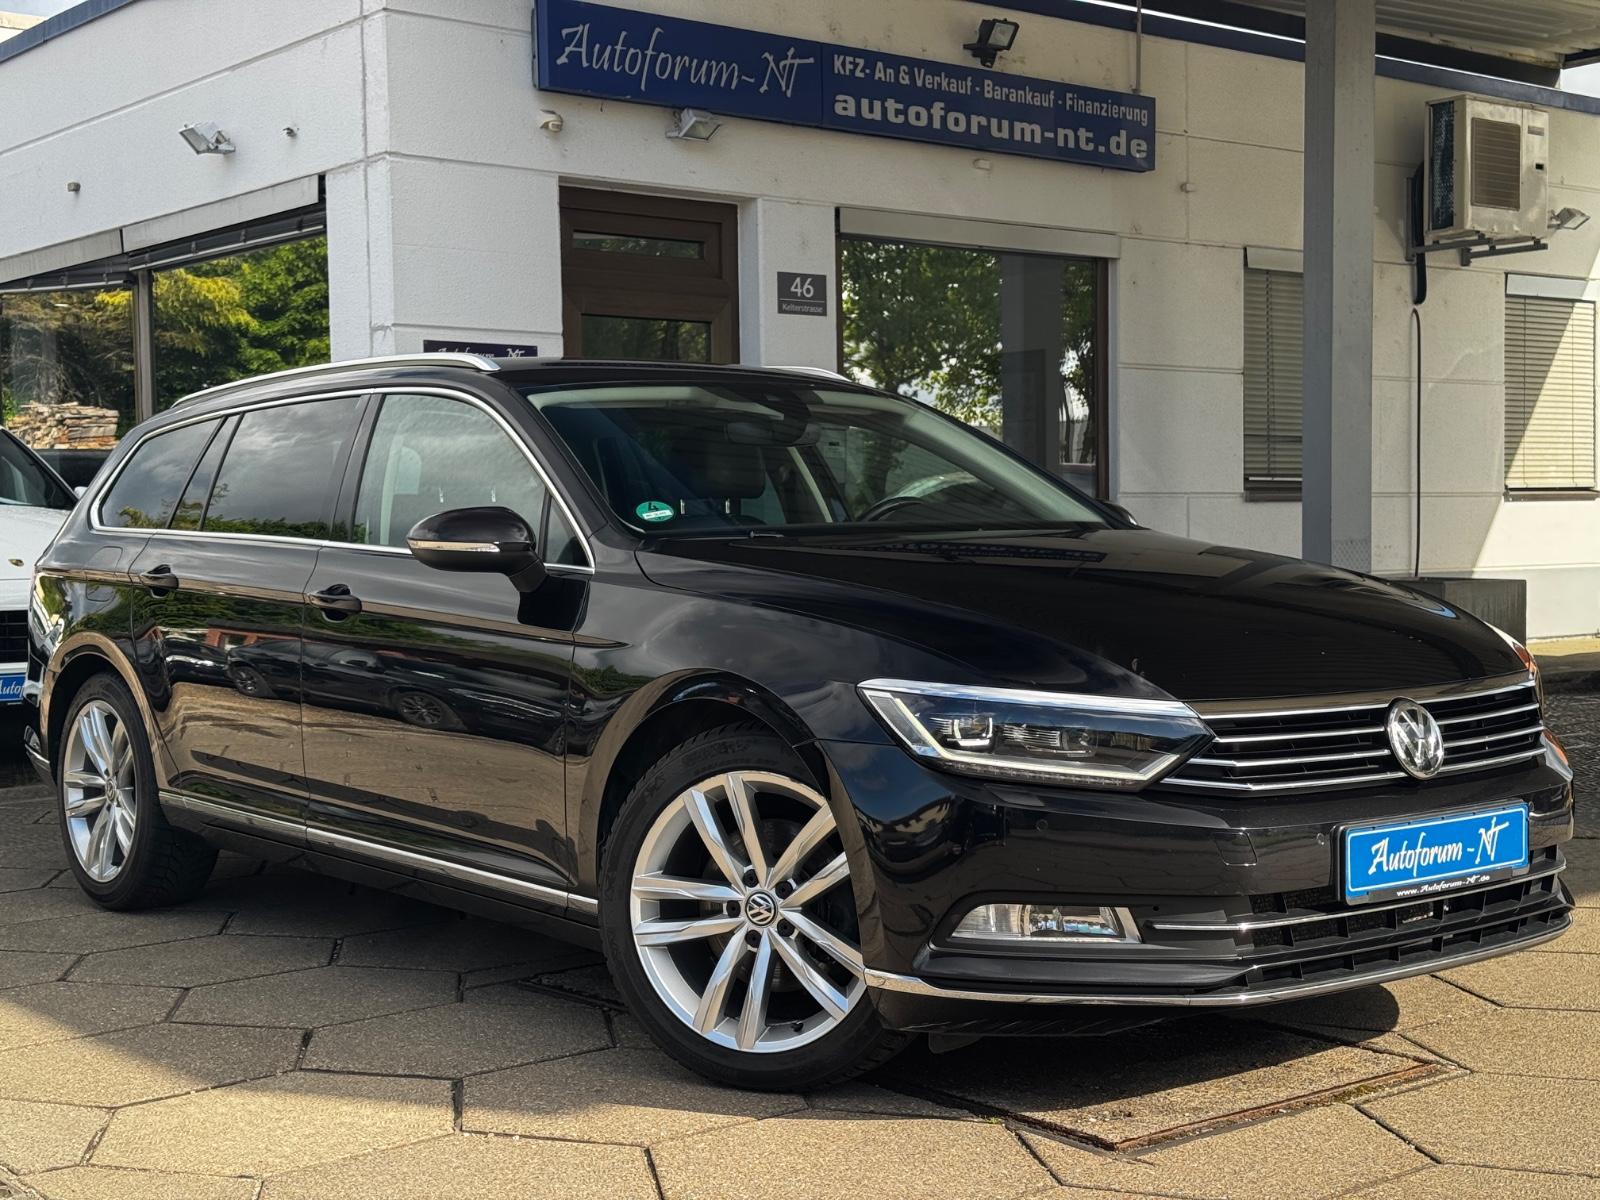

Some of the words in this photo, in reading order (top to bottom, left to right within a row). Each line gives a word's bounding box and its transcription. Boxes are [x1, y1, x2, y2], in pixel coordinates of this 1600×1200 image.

[834, 94, 1148, 159] autoforum-nt.de
[898, 69, 910, 85] &
[914, 68, 973, 95] Verkauf
[984, 80, 1055, 108] Barankauf
[1066, 93, 1148, 127] Finanzierung
[790, 276, 814, 298] 46
